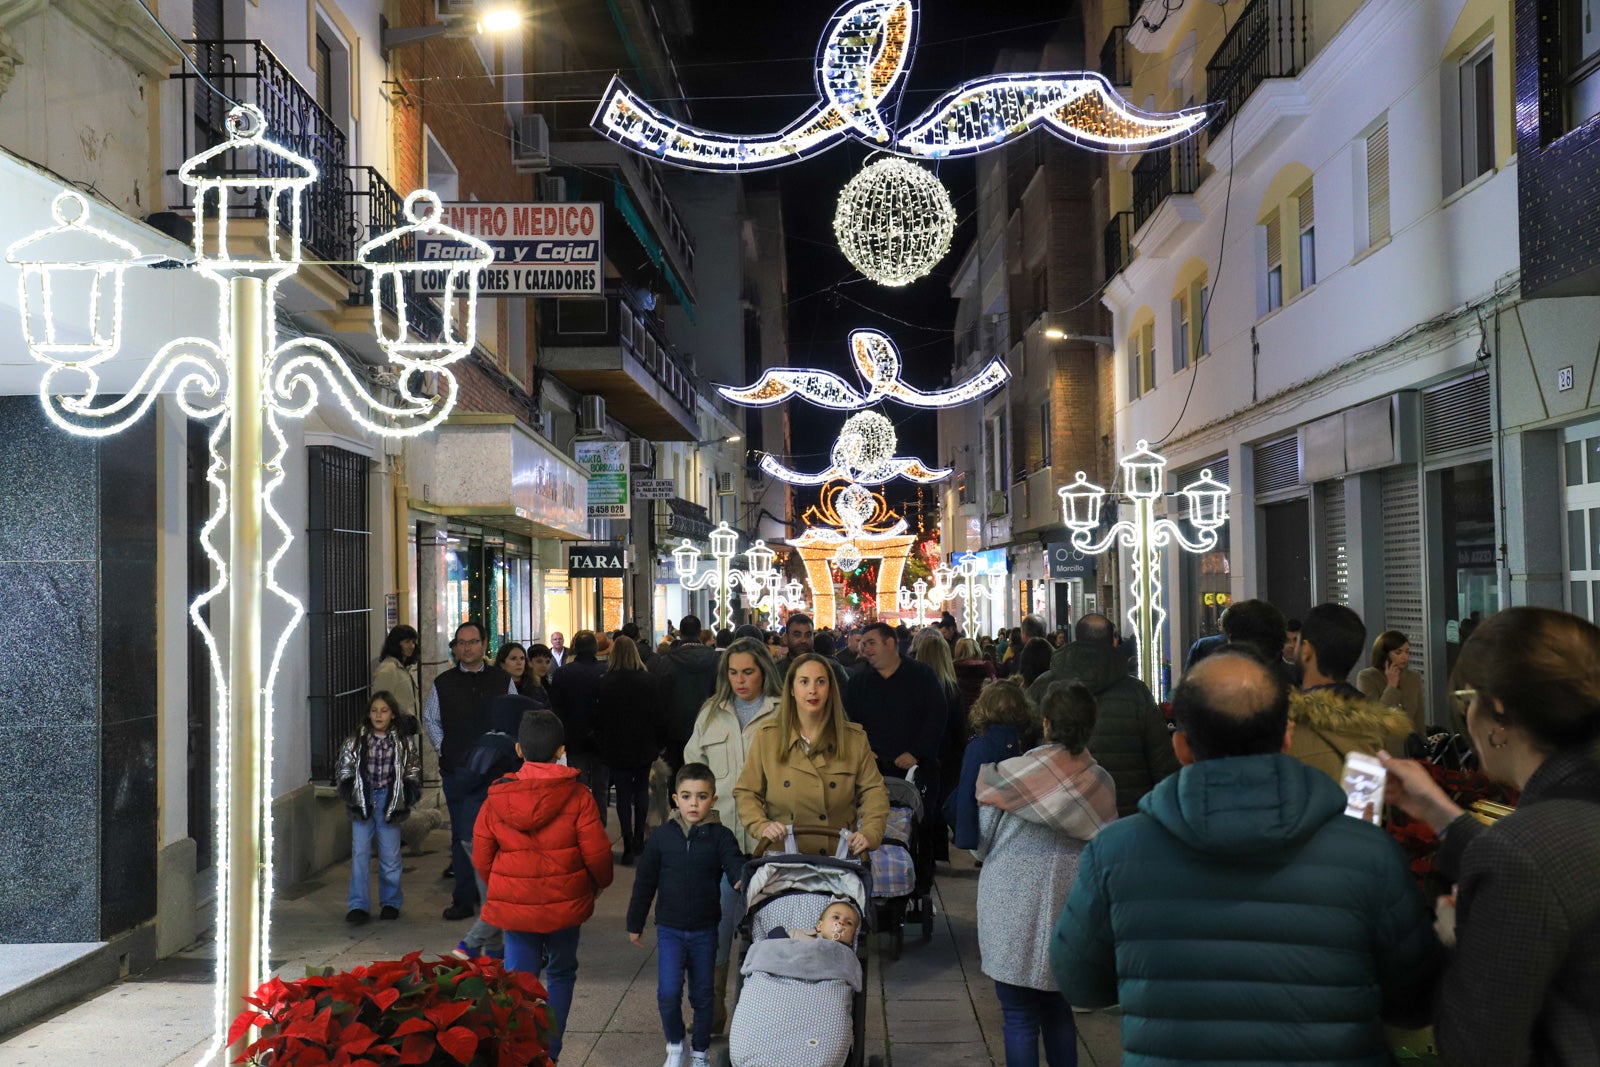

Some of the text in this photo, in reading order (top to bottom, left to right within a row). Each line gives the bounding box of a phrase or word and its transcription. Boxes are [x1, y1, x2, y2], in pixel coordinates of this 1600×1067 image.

[513, 206, 594, 236] MEDICO
[513, 246, 529, 262] y
[535, 243, 595, 262] Cajal
[421, 269, 596, 290] CONUCORES Y CAZADORES
[1561, 370, 1571, 387] 26
[596, 505, 609, 513] 458
[610, 505, 624, 513] 028
[570, 555, 621, 569] TARA
